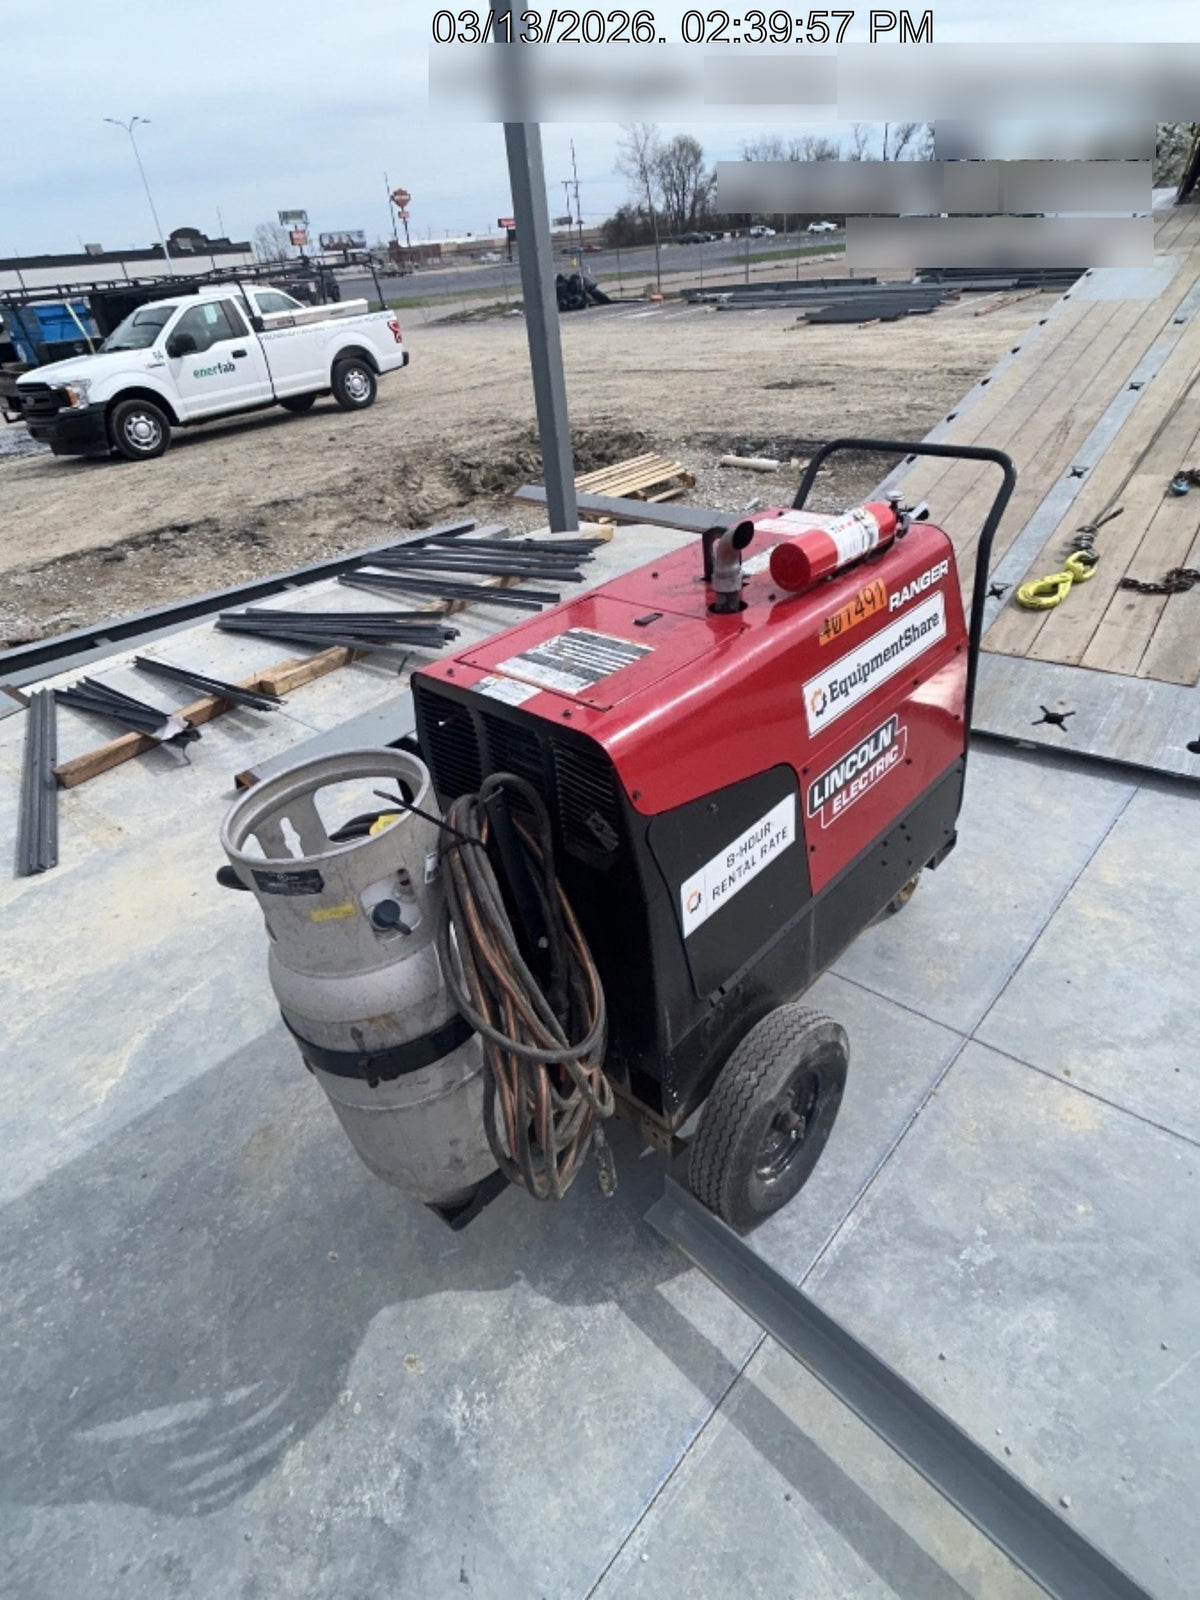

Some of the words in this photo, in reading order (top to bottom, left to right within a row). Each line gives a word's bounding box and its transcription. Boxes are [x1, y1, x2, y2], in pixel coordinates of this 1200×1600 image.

[193, 360, 236, 379] enerfab
[889, 559, 949, 612] RANGER
[828, 612, 940, 703] EquipmentShare
[813, 723, 893, 809] LINCOLN
[832, 745, 899, 815] ELECTRIC
[712, 857, 757, 900] RENTAL
[760, 826, 788, 858] RATE
